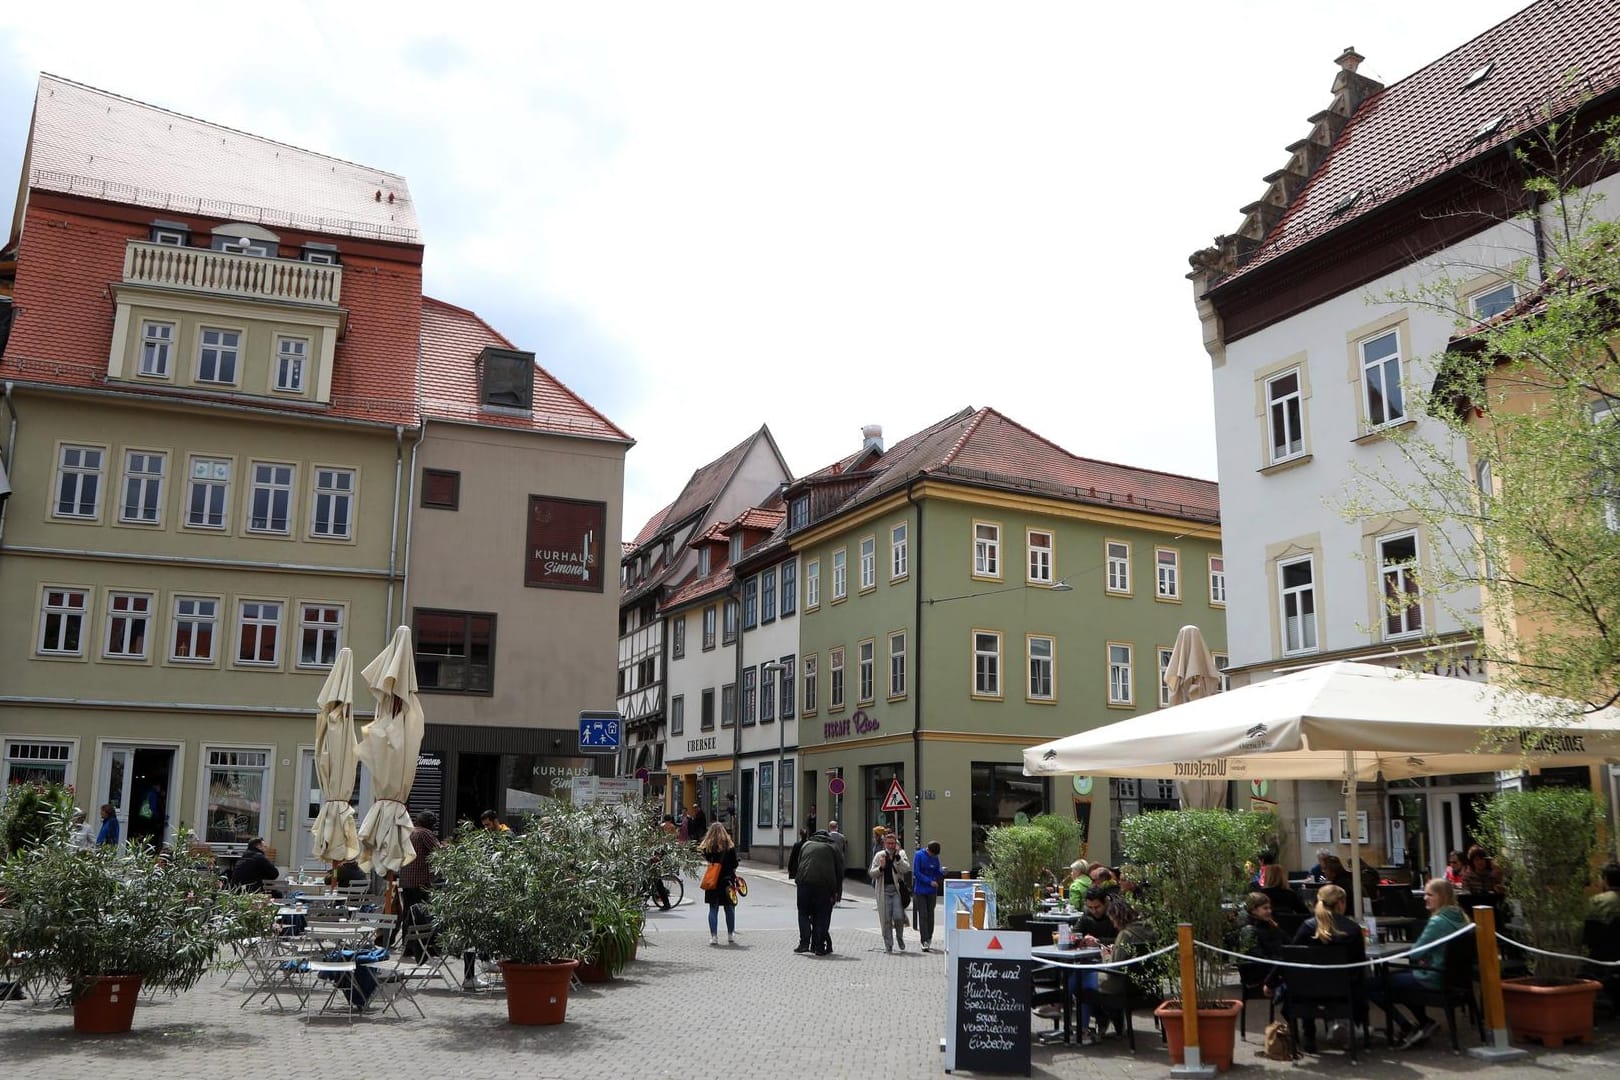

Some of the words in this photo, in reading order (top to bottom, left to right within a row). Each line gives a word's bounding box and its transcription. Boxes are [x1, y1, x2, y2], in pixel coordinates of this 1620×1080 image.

[535, 549, 594, 564] KURHAUS
[544, 561, 584, 576] Simone
[532, 765, 589, 777] KURHAUS
[1002, 965, 1021, 980] und
